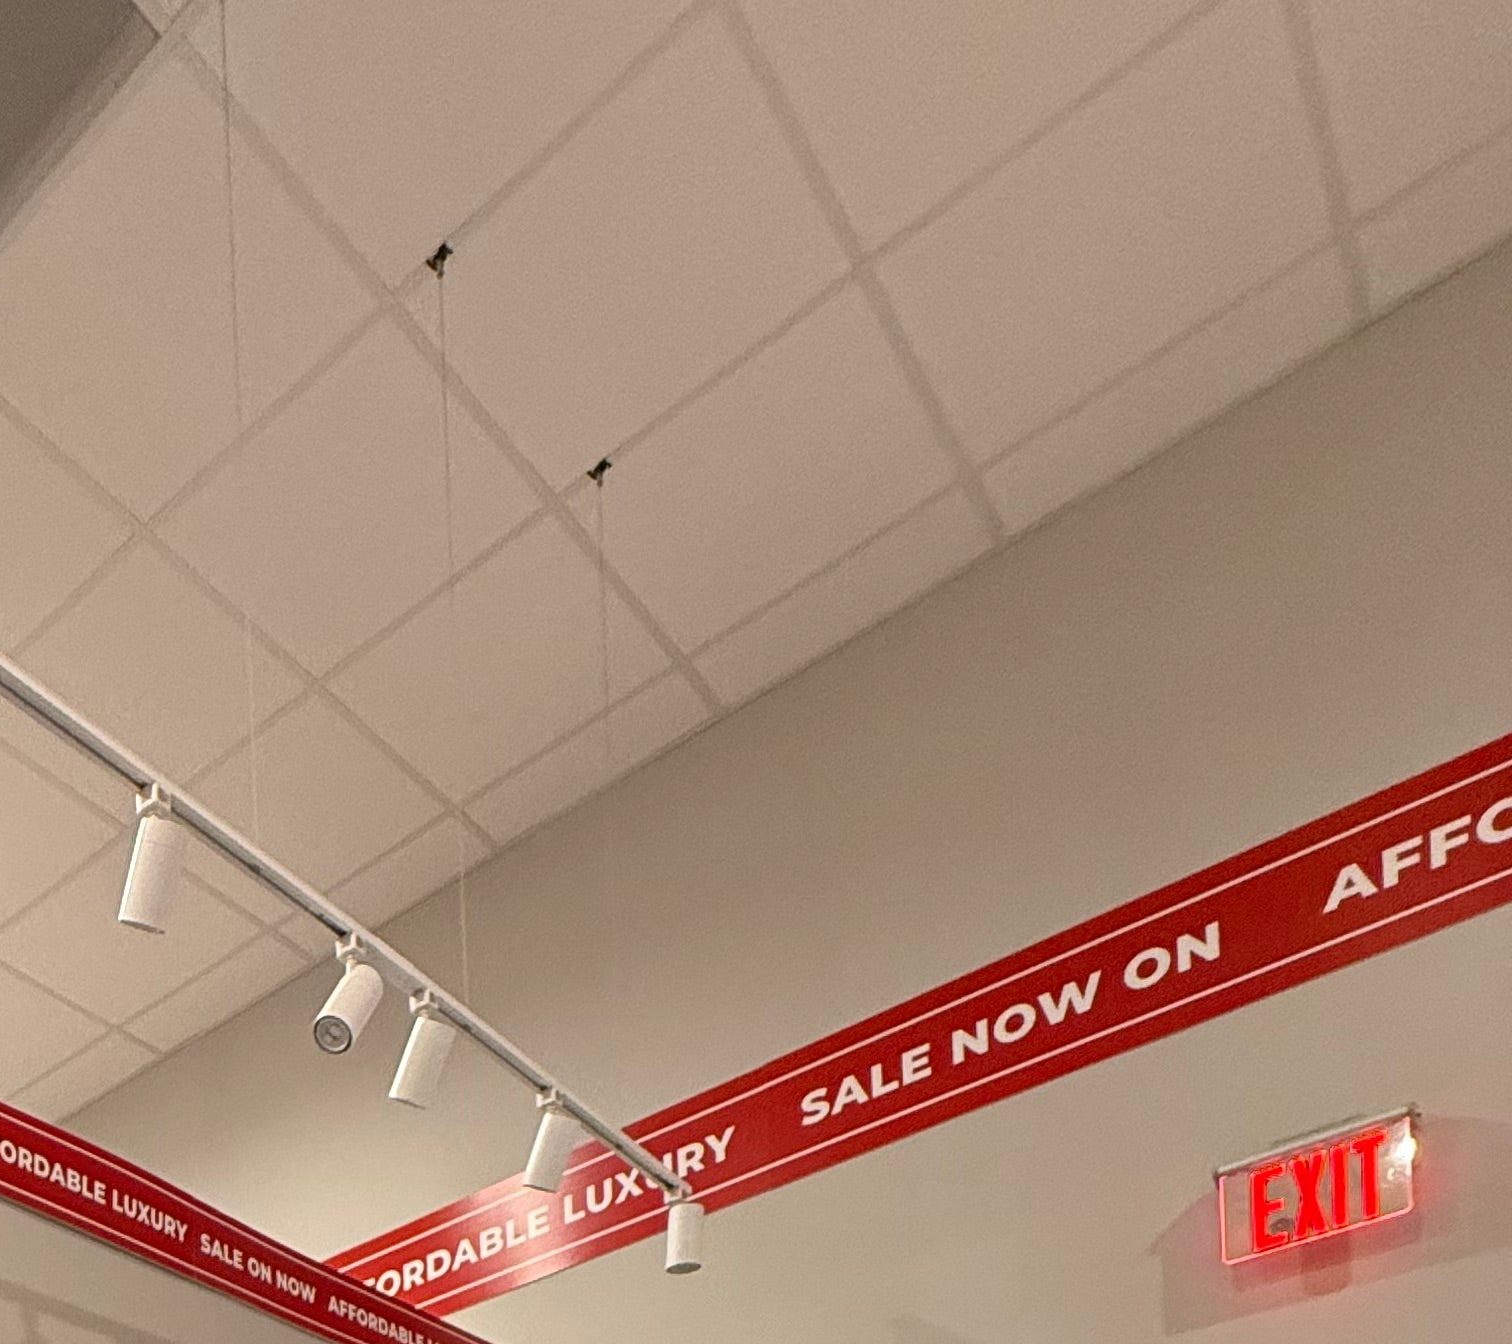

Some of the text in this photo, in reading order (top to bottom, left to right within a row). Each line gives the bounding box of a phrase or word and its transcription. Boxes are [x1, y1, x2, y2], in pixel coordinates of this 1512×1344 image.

[363, 1205, 550, 1297] ORDABLE
[801, 1043, 933, 1125] SALE
[951, 971, 1103, 1066] NOW
[1123, 922, 1221, 991] ON
[112, 1189, 188, 1242] LUXURY
[200, 1233, 243, 1270] SALE
[247, 1258, 272, 1284] ON
[275, 1270, 317, 1304] NOW
[1249, 1128, 1388, 1253] EXIT
